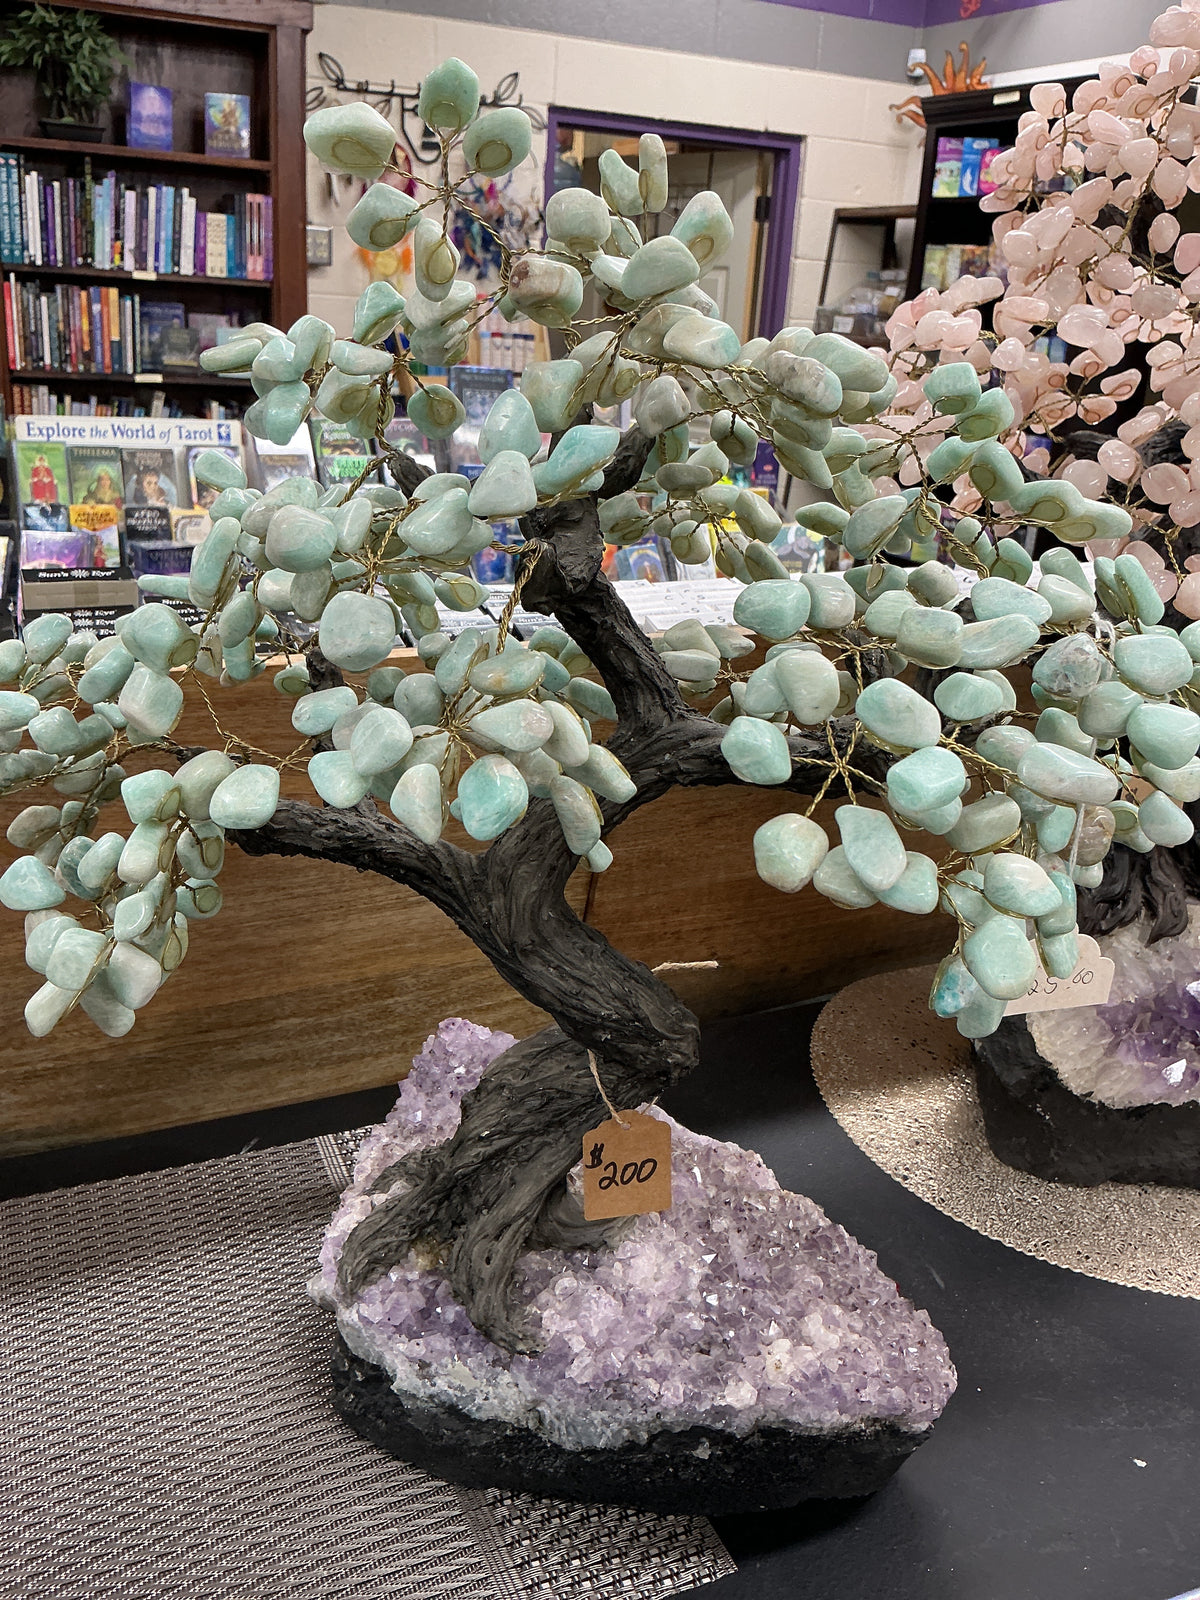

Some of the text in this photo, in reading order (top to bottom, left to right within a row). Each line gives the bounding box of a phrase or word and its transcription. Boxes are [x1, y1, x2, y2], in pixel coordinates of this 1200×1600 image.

[26, 422, 213, 443] Explore the World of Tarot
